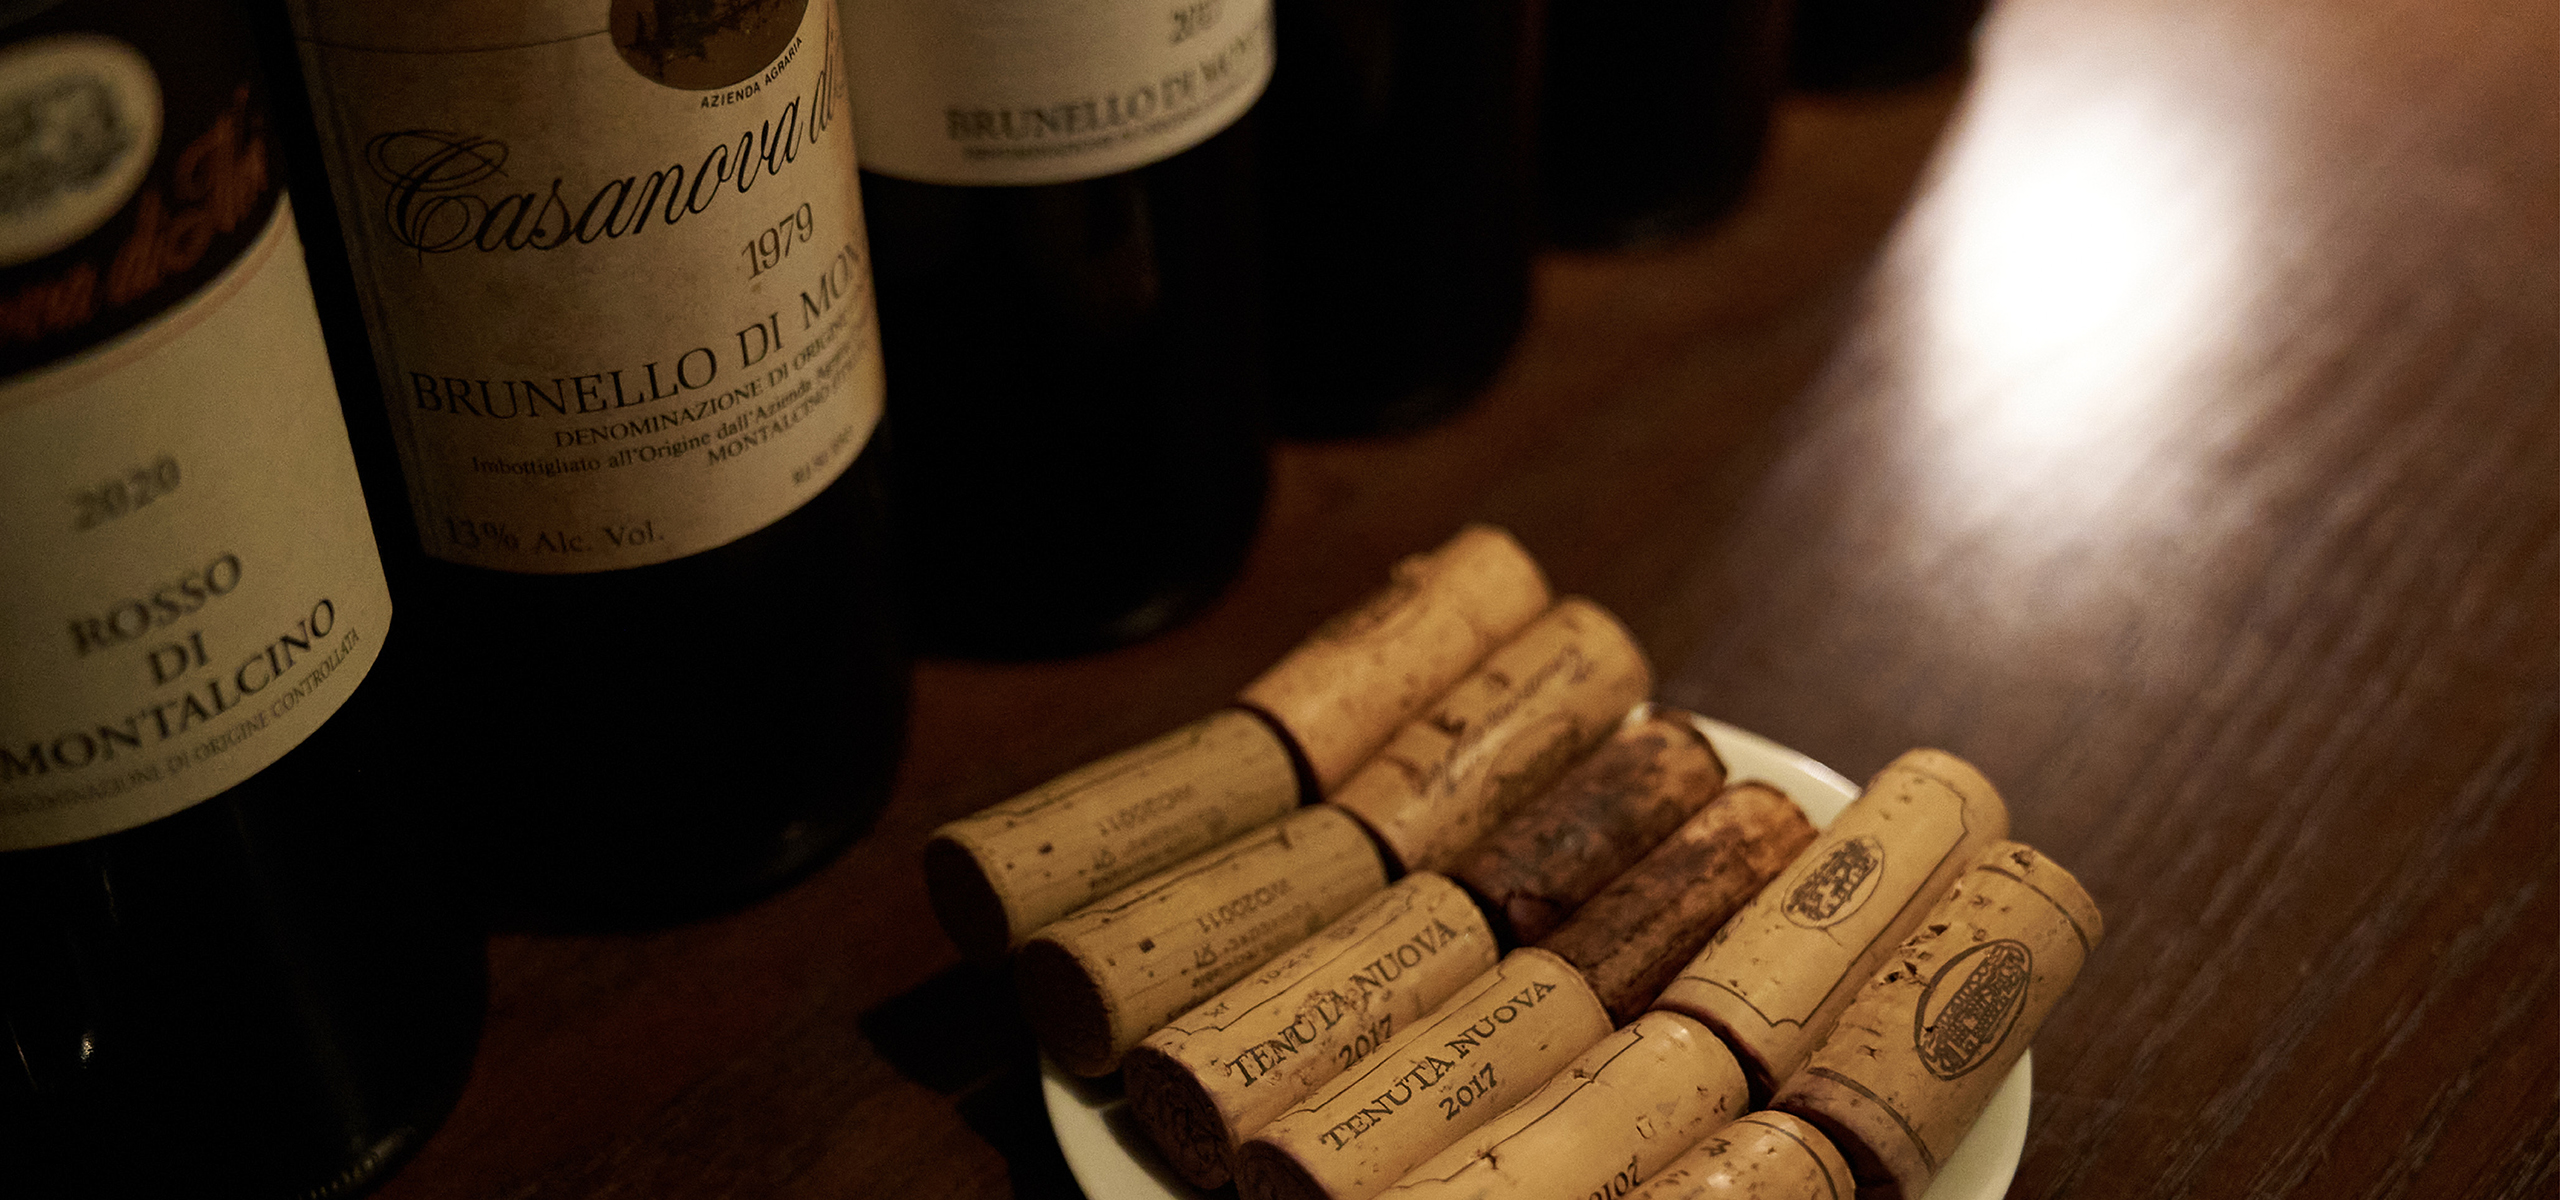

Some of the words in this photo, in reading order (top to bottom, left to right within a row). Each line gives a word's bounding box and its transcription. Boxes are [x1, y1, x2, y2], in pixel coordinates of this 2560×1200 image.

[701, 82, 760, 109] AZIENDA
[764, 36, 802, 86] AGRARIA
[365, 95, 803, 265] Casanova
[741, 202, 813, 281] 1979
[408, 346, 718, 421] BRUNELLO
[735, 311, 784, 369] DI
[554, 378, 763, 451] DENOMINAZIONE
[768, 362, 789, 388] DI
[472, 455, 600, 480] Imbottigliato
[607, 432, 711, 469] all'Origine
[717, 379, 812, 441] dall'Azienda
[70, 455, 182, 533] 2020
[446, 516, 519, 550] 13%
[535, 530, 592, 554] Alc.
[604, 518, 664, 547] Vol.
[67, 551, 242, 658] ROSSO
[0, 599, 336, 782] MONTALCINO
[147, 630, 209, 687] DI
[195, 711, 269, 761] ORIGINE
[270, 625, 360, 718] CONTROLLATA
[1223, 988, 1347, 1088] TENUTA
[1350, 918, 1457, 999] NUOVA
[1338, 1013, 1394, 1070] 2017
[1320, 1055, 1455, 1151] TENUTA
[1445, 980, 1557, 1060] NUOVA
[1438, 1062, 1498, 1121] 2017
